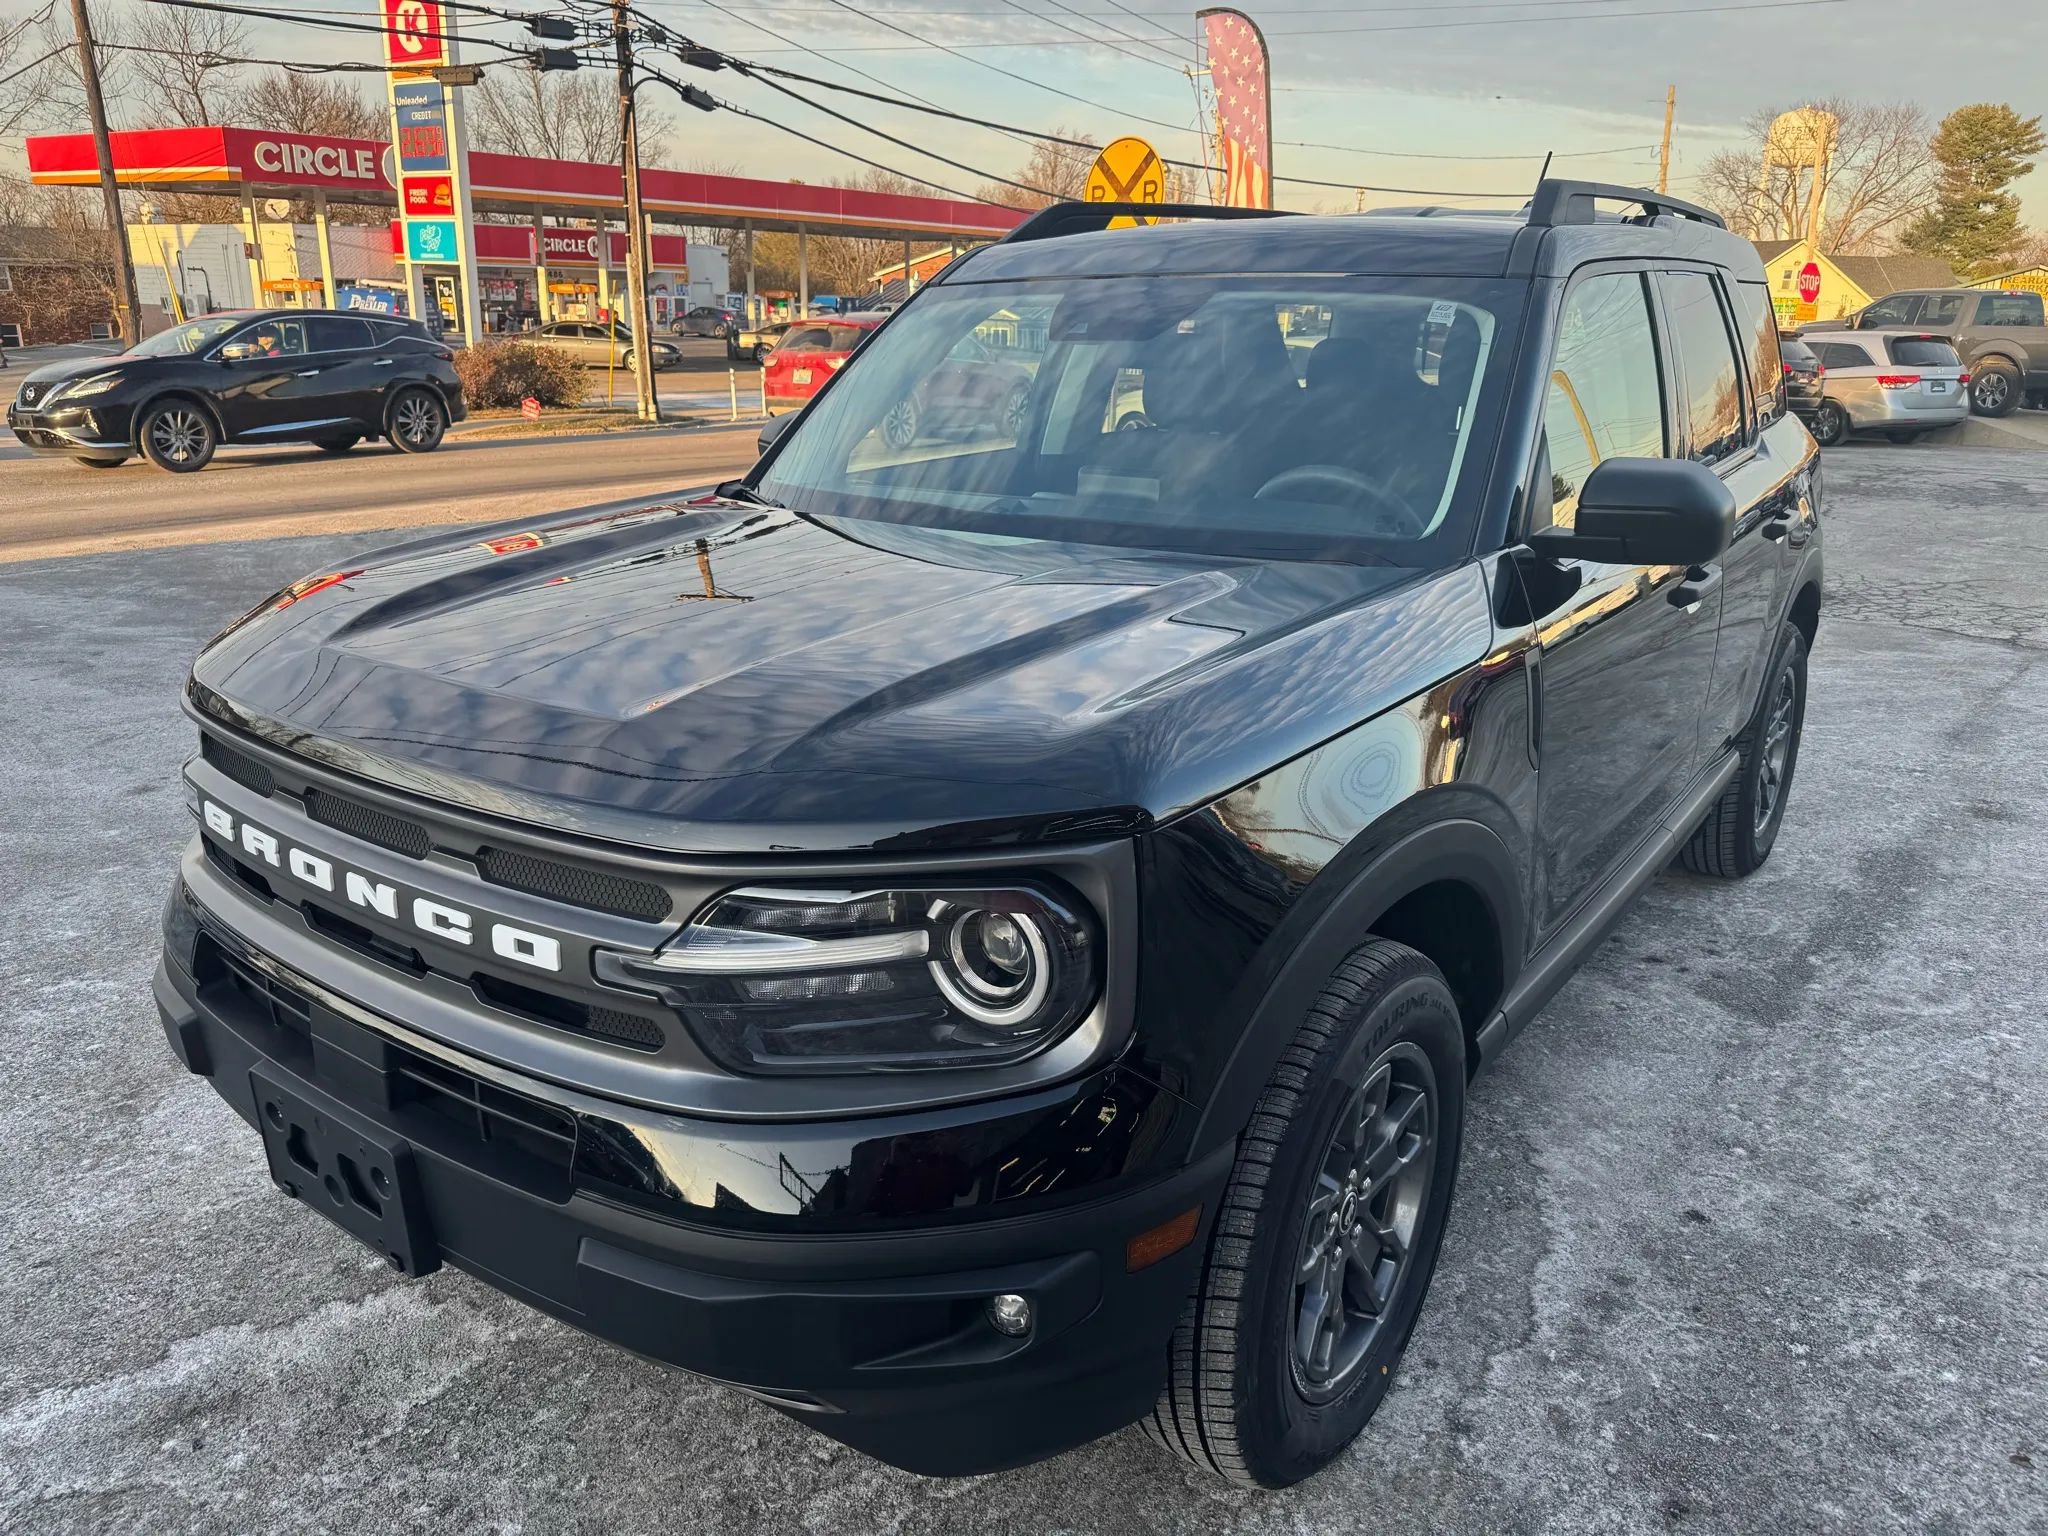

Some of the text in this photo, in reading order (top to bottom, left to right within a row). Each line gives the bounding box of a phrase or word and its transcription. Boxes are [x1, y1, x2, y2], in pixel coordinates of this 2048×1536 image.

[397, 95, 428, 106] Unleaded
[411, 111, 432, 121] CREDIT
[254, 141, 376, 179] CIRCLE
[409, 188, 428, 197] FRESH
[1143, 179, 1158, 203] R
[543, 237, 586, 253] CIRCLE
[1800, 274, 1820, 291] STOP
[203, 799, 562, 972] BRONCO
[1362, 992, 1429, 1060] TOURING
